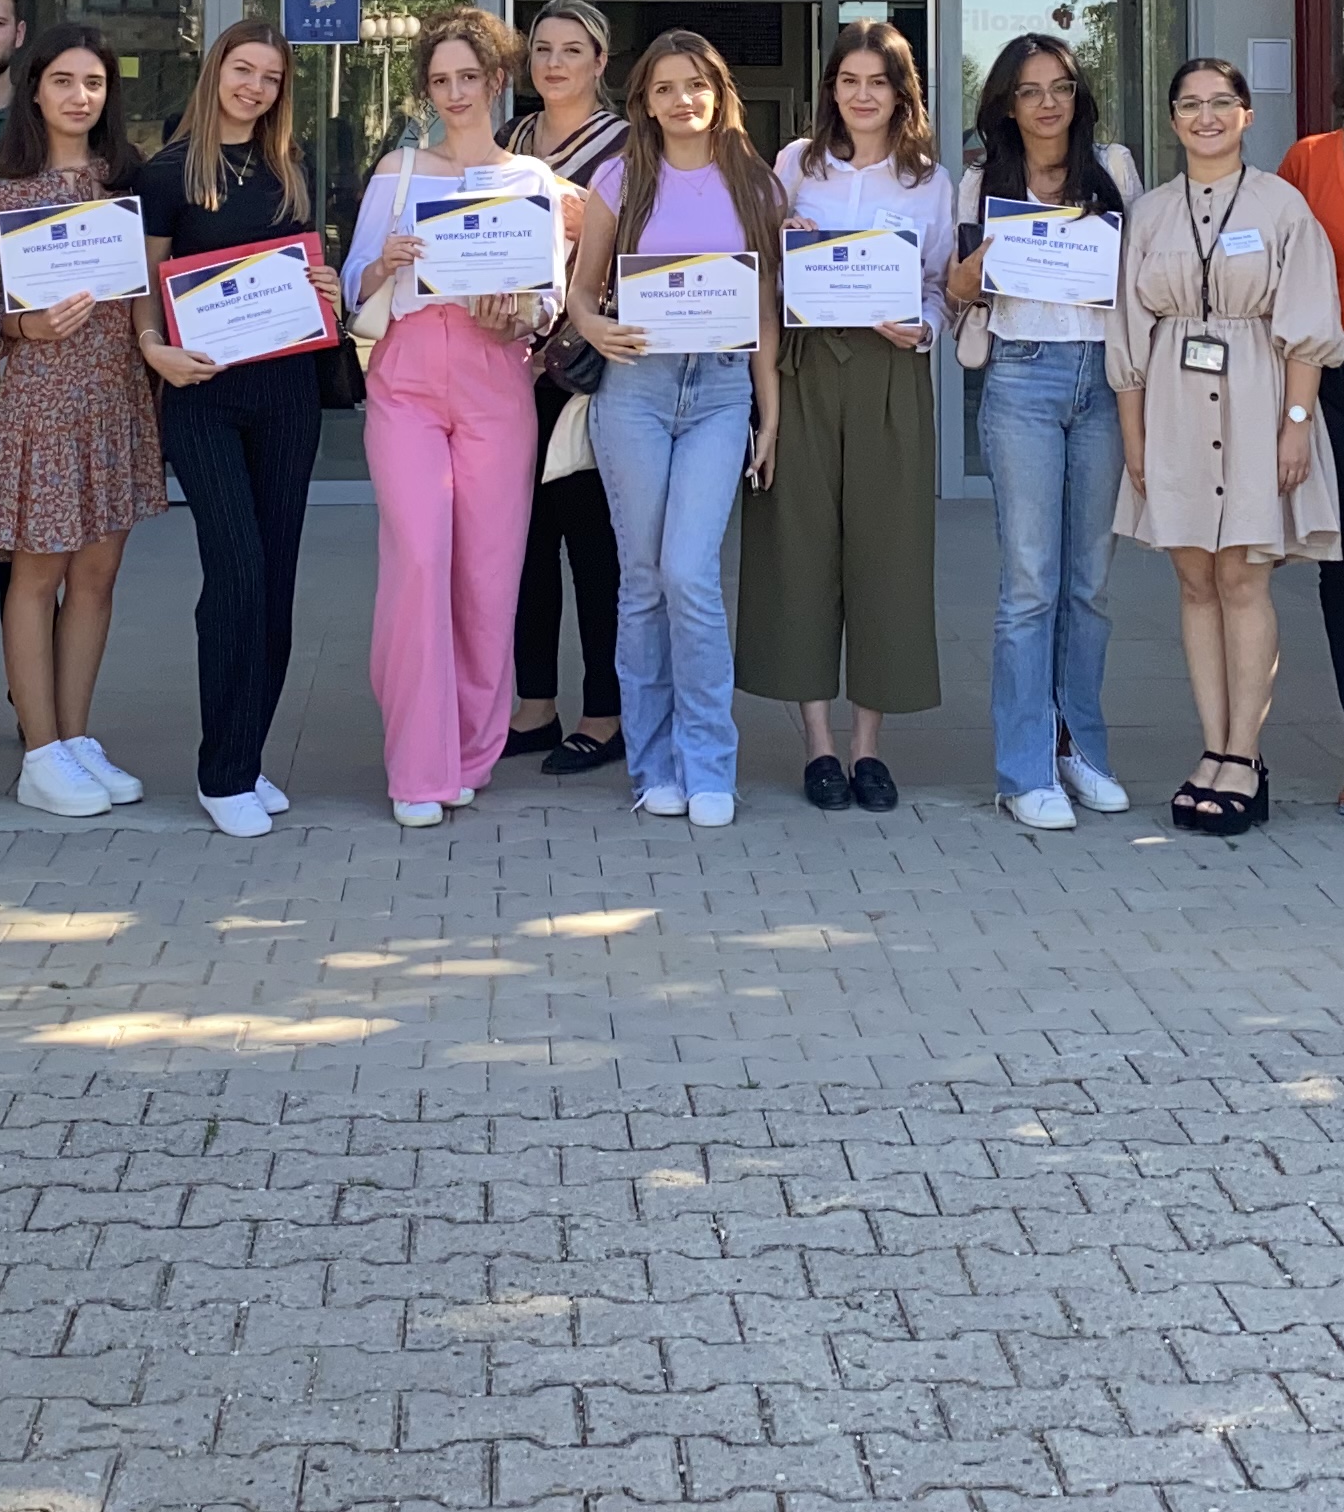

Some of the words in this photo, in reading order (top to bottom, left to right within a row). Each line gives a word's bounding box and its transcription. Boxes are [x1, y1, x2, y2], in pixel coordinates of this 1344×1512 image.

[435, 232, 480, 240] WORKSHOP
[482, 230, 532, 239] CERTIFICATE
[22, 242, 70, 254] WORKSHOP
[71, 235, 123, 248] CERTIFICATE
[1003, 235, 1048, 246] WORKSHOP
[1049, 240, 1098, 253] CERTIFICATE
[804, 264, 850, 272] WORKSHOP
[851, 264, 900, 272] CERTIFICATE
[196, 295, 242, 314] WORKSHOP
[243, 282, 293, 302] CERTIFICATE
[640, 290, 686, 299] WORKSHOP
[687, 288, 737, 297] CERTIFICATE
